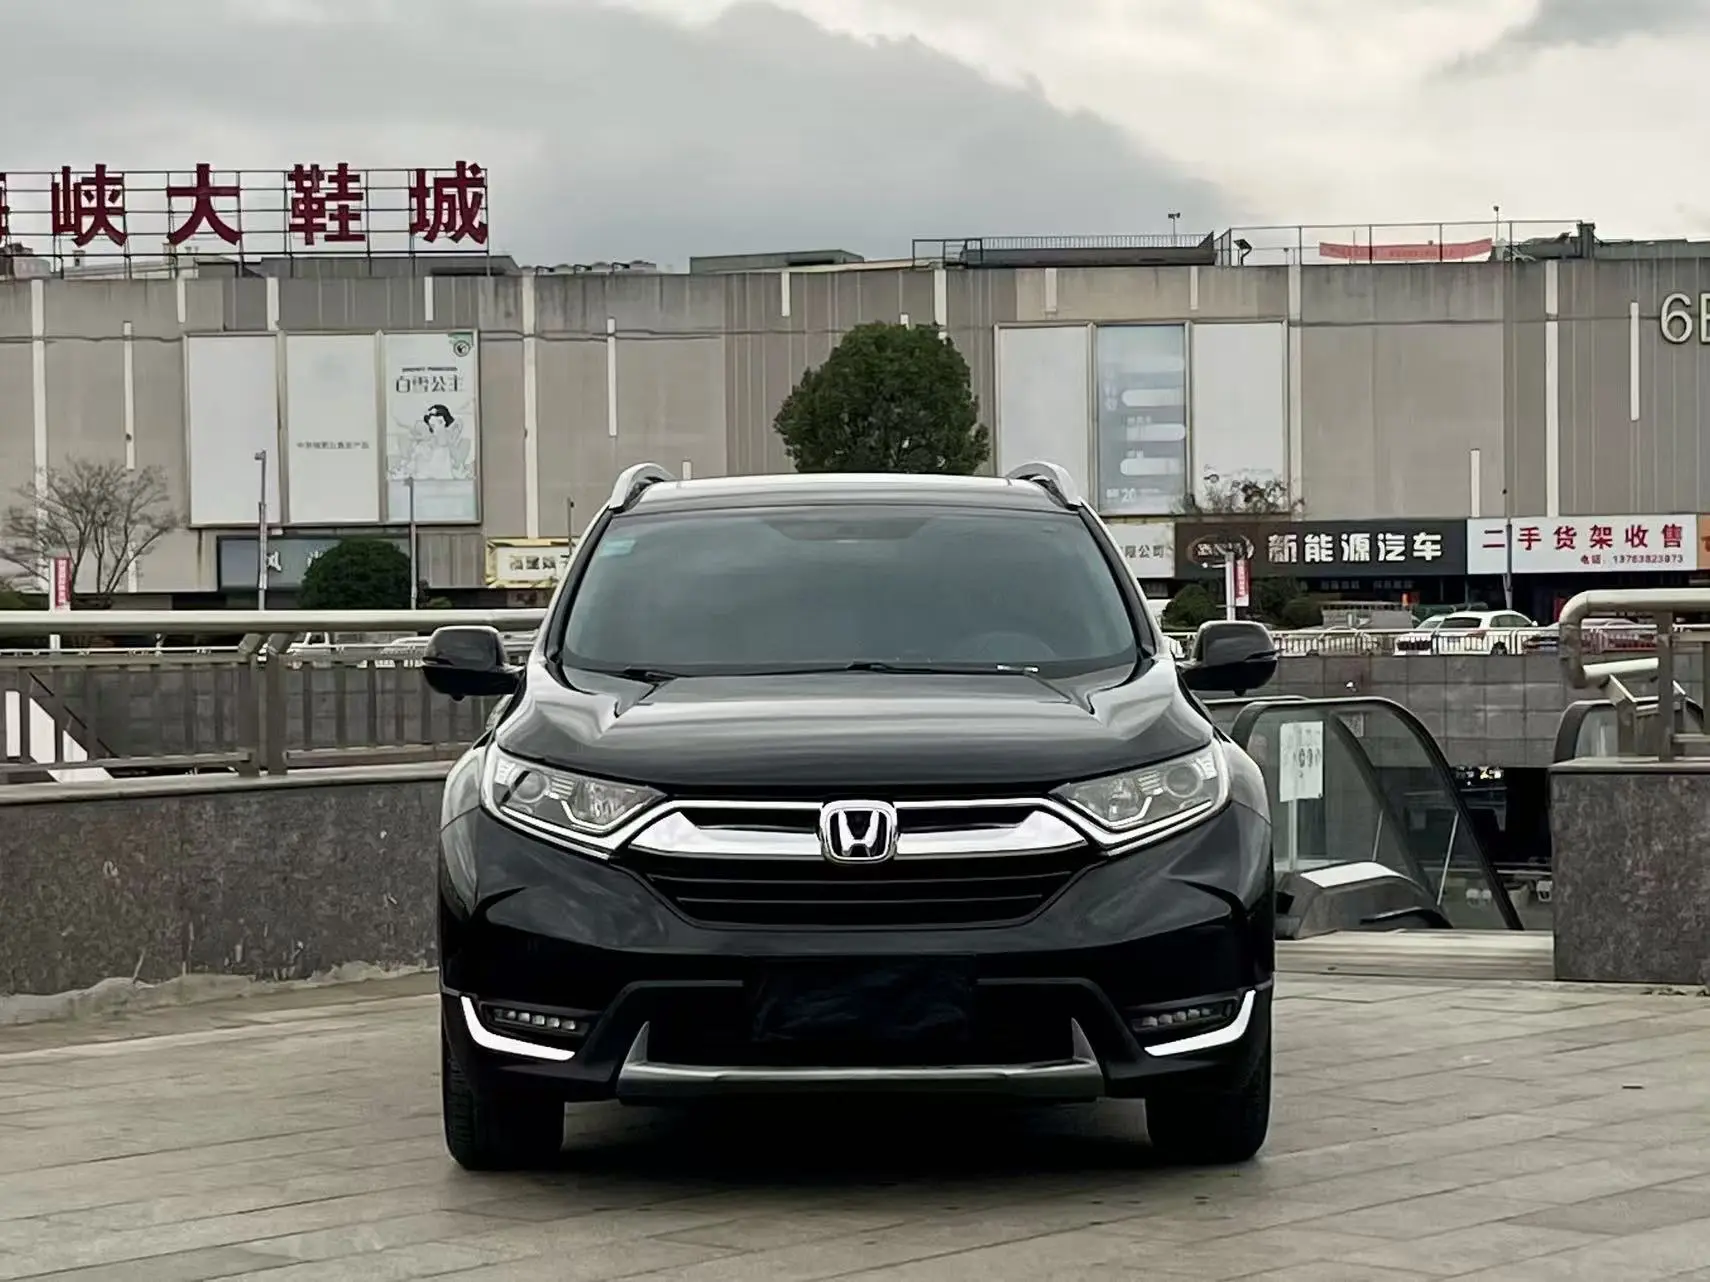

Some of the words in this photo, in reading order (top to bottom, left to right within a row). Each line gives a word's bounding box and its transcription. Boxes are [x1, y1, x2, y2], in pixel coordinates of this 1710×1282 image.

[0, 161, 488, 246] 峡大鞋城
[1268, 532, 1442, 562] 新能源汽车
[1482, 523, 1684, 550] 二手货架收售
[1120, 545, 1165, 558] 限公司
